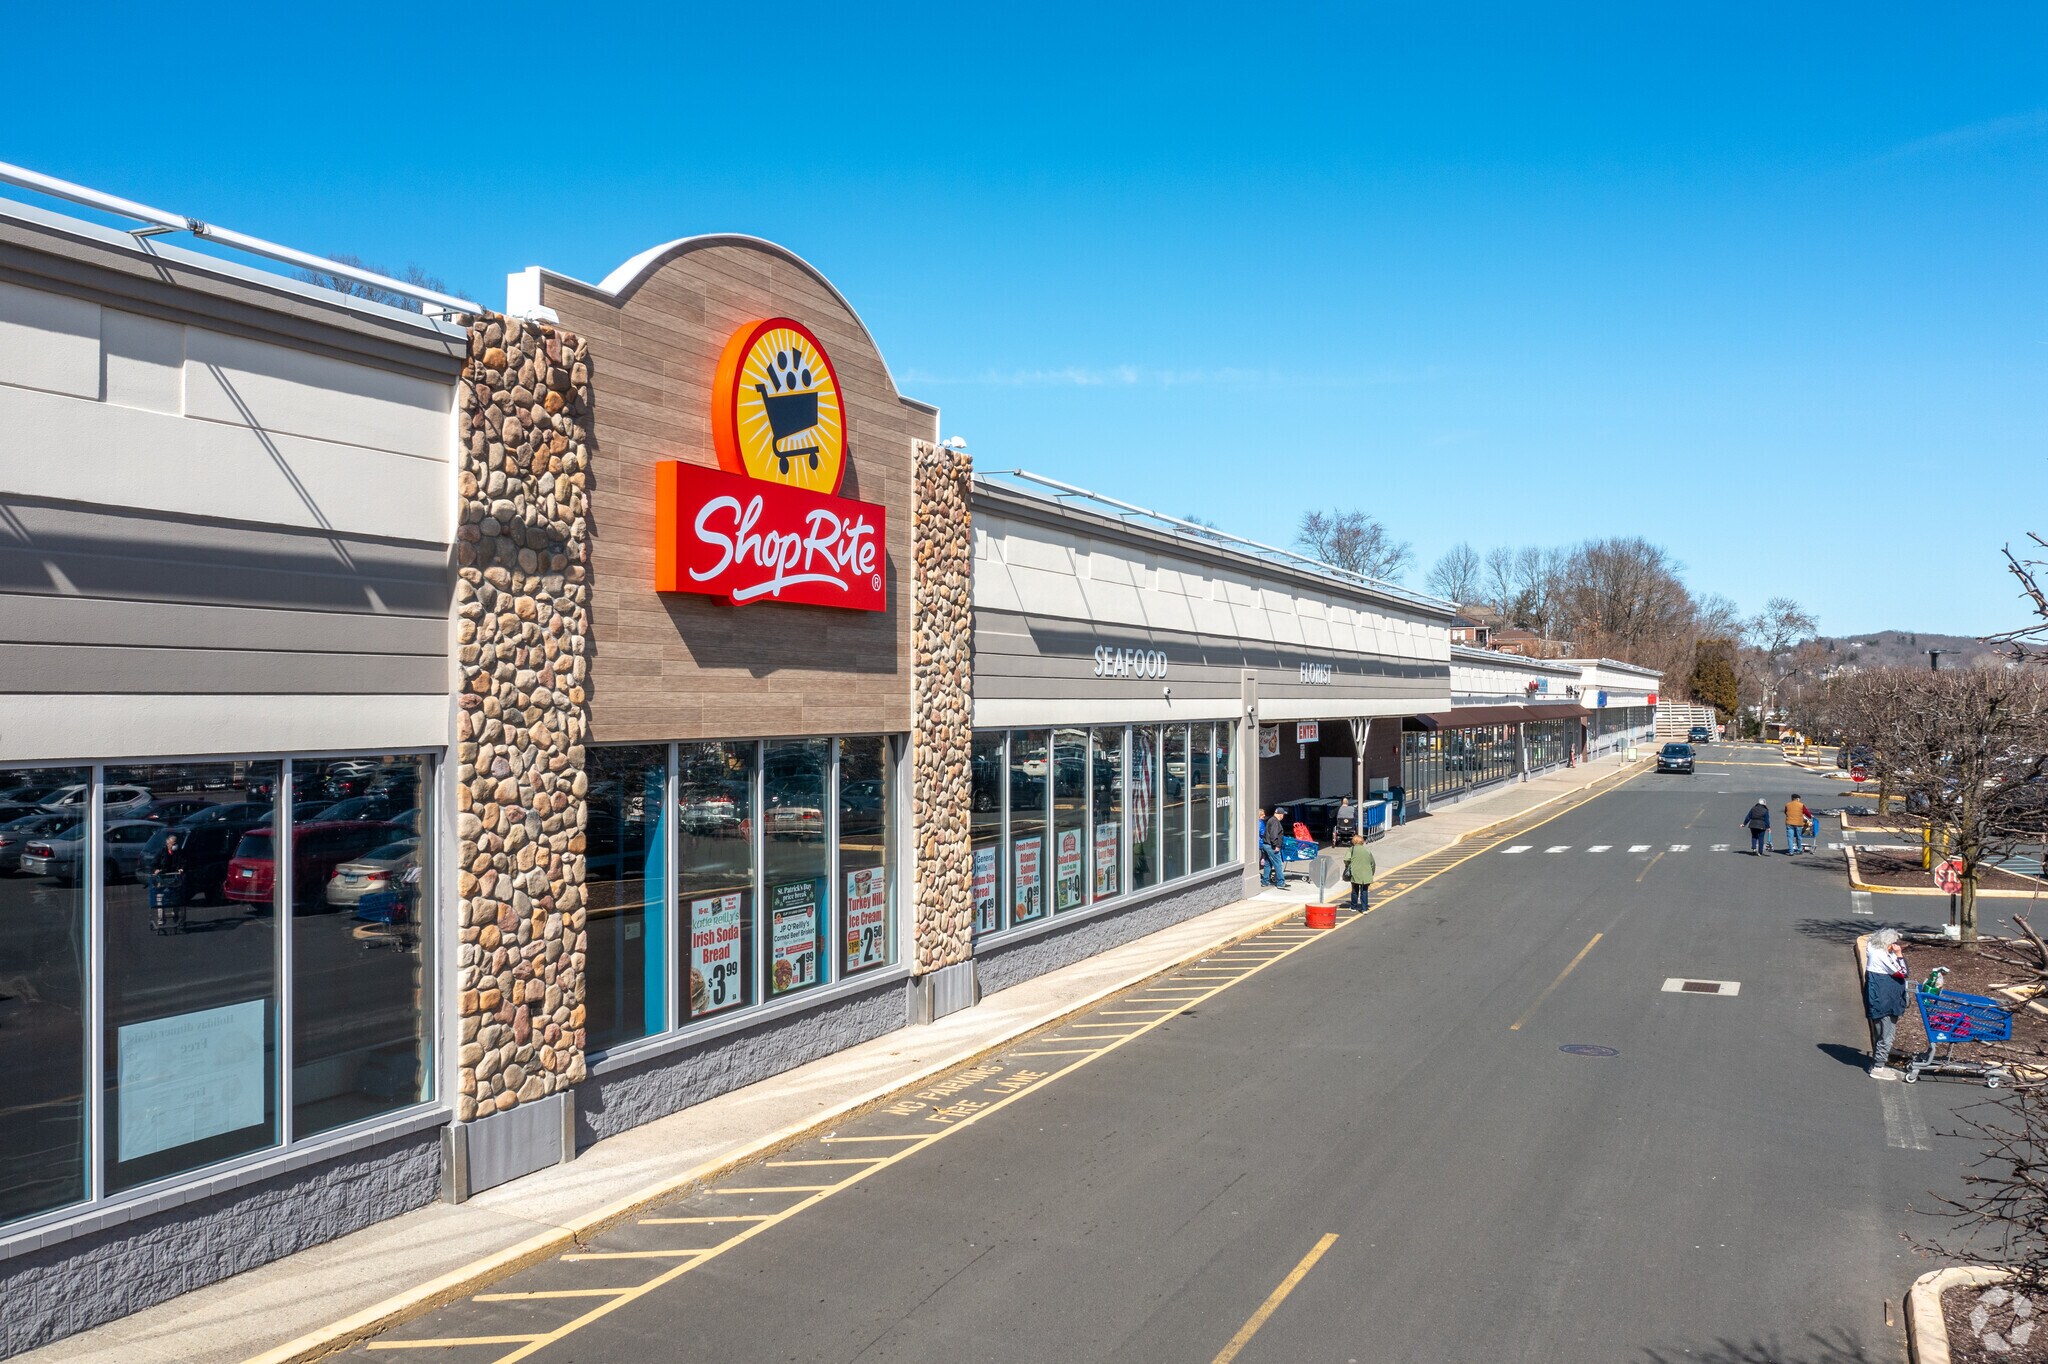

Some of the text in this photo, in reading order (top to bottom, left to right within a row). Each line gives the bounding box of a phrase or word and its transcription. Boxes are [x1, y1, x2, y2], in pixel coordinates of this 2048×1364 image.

[689, 495, 876, 600] ShopRite
[1094, 645, 1168, 678] SEAFOOD
[1300, 662, 1332, 684] FLORIST
[1299, 725, 1317, 739] ENTER
[976, 854, 994, 864] General
[848, 892, 883, 911] Turkey Hill
[849, 910, 882, 928] Ice Cream
[693, 925, 739, 948] Irish Soda
[703, 943, 730, 964] Bread
[880, 1065, 1004, 1116] NO PARKING
[925, 1069, 1049, 1123] FIRE LANE
